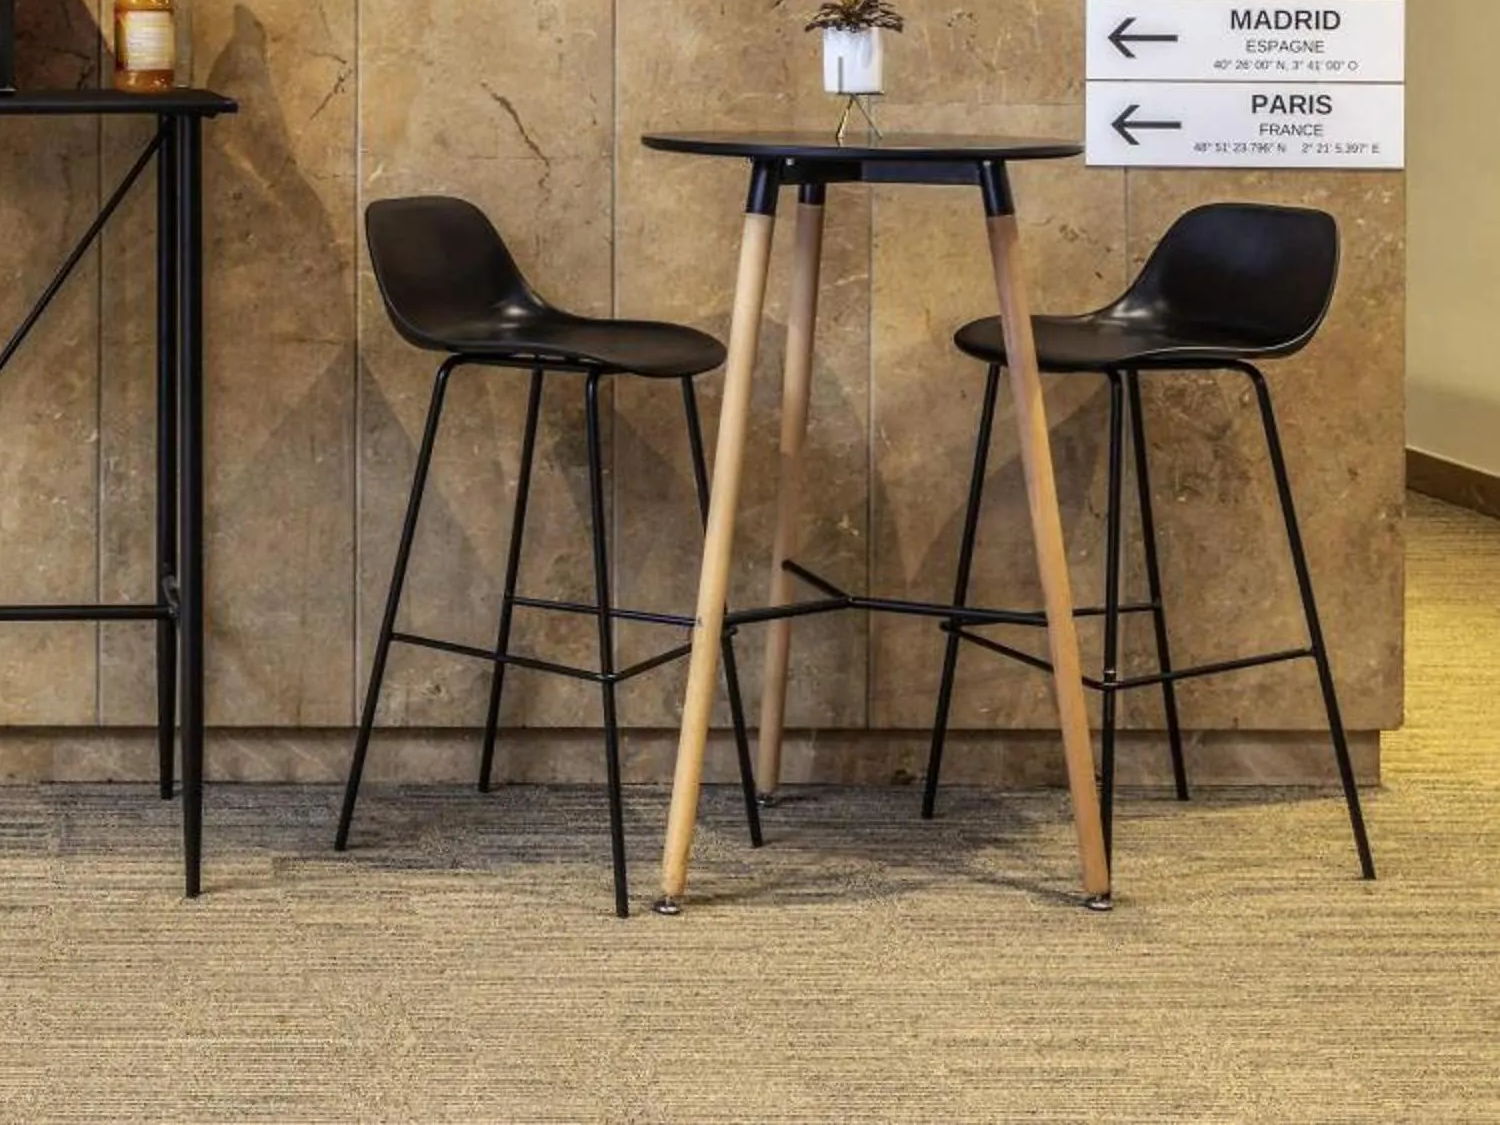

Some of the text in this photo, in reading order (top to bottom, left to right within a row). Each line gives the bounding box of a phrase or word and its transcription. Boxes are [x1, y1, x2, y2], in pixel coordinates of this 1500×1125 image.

[1231, 9, 1342, 31] MADRID
[1245, 39, 1325, 55] ESPAGNE
[1252, 94, 1333, 116] PARIS
[1259, 123, 1324, 137] FRANCE
[1277, 142, 1287, 154] N
[1371, 142, 1380, 154] E
